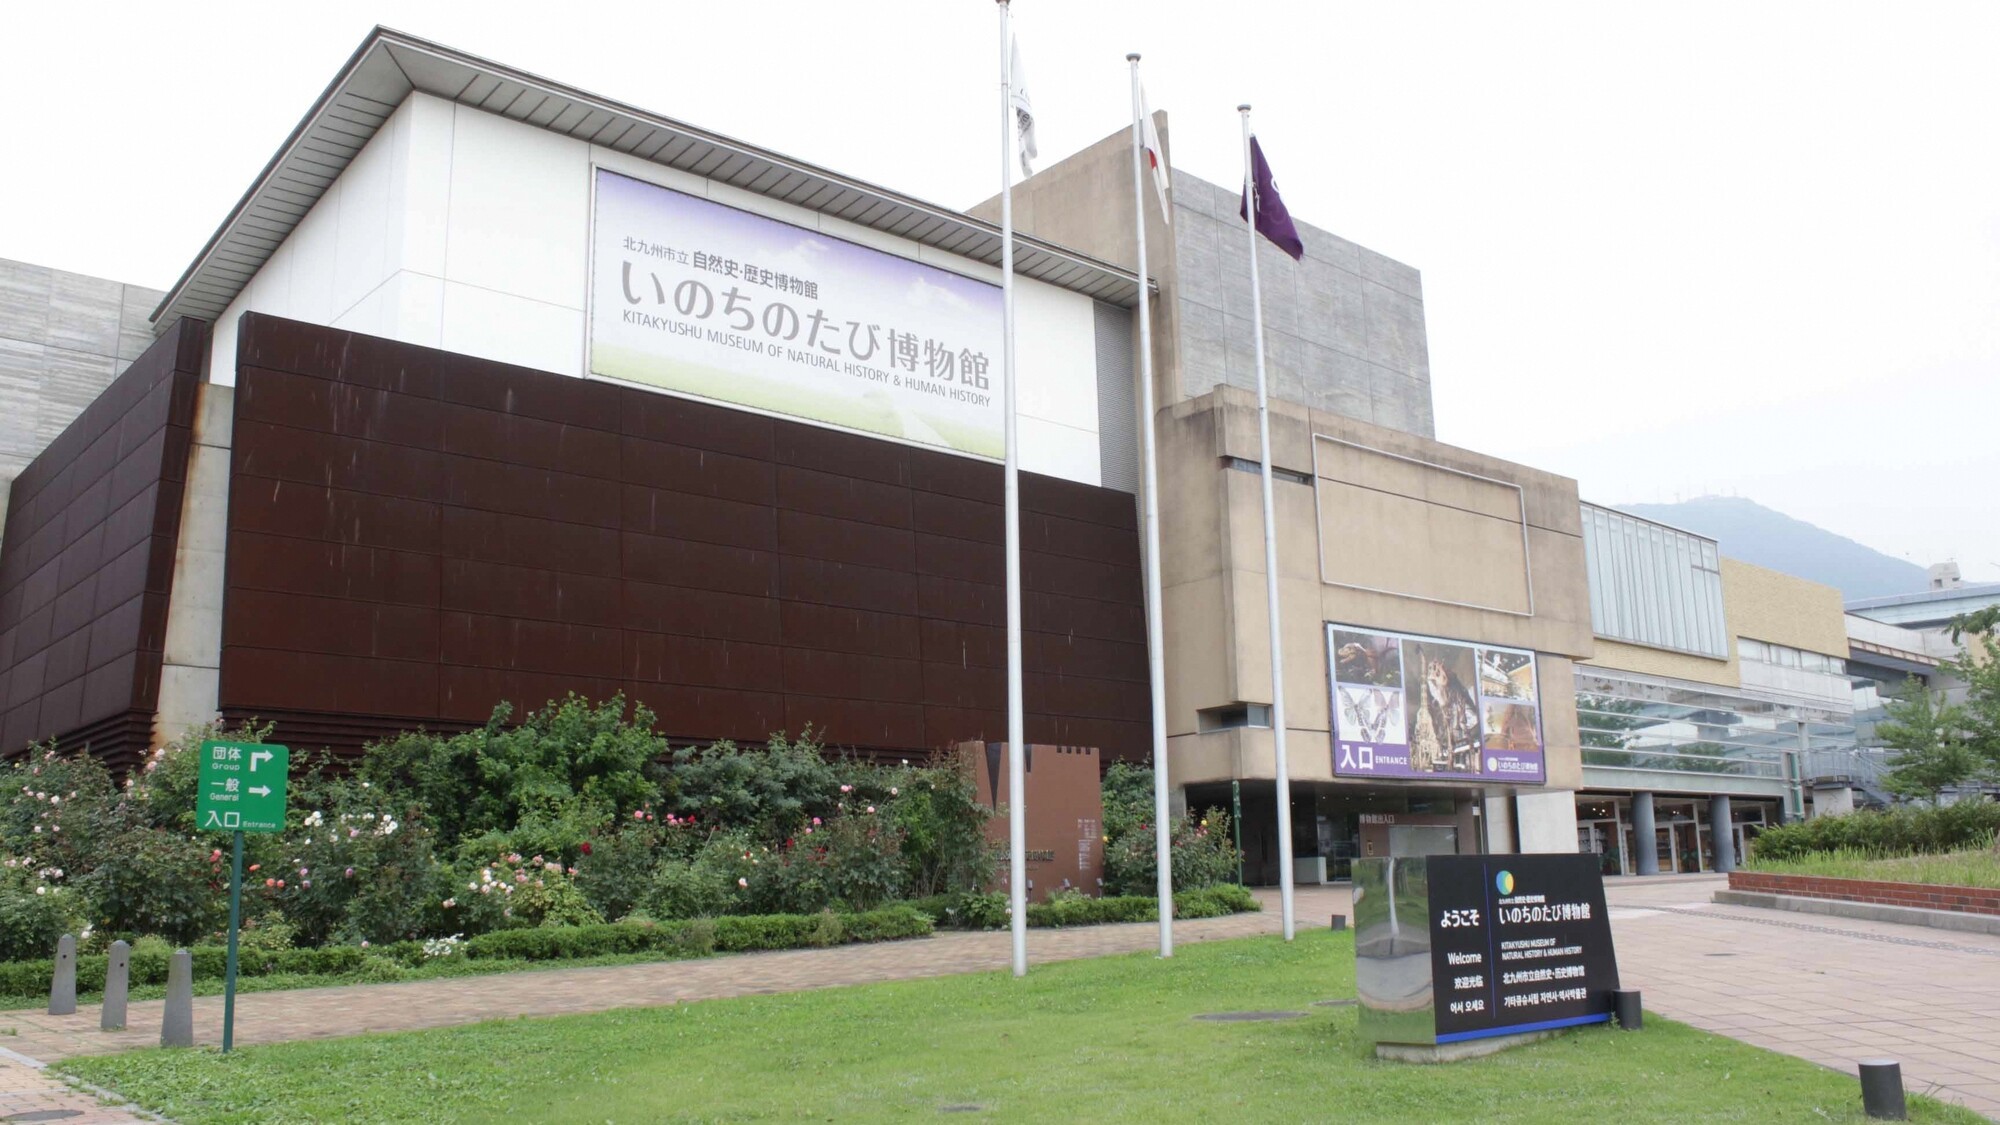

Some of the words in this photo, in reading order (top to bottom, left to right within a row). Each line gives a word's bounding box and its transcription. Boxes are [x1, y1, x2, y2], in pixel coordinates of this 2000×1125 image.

[623, 236, 689, 265] 北九州市立
[621, 260, 990, 390] いのちのたび博物館
[623, 309, 702, 340] KITAKYUSHU
[707, 329, 763, 354] MUSEUM
[767, 343, 783, 358] OF
[787, 349, 840, 372] NATURAL
[844, 361, 889, 384] HISTORY
[893, 374, 901, 386] &
[905, 376, 946, 397] HUMAN
[949, 388, 991, 408] HISTORY
[212, 746, 242, 761] 団体
[1340, 744, 1373, 770] 入口
[1375, 755, 1407, 765] ENTRANCE
[211, 762, 240, 771] Group
[210, 777, 240, 792] 一般
[209, 792, 239, 802] General
[204, 810, 240, 828] 入口
[242, 820, 276, 829] Entrance
[1440, 909, 1480, 928] ようこそ
[1499, 902, 1591, 924] いのちのたび博物館
[1501, 940, 1530, 950] KITAKYUSHU
[1530, 938, 1550, 948] MUSEUM
[1550, 937, 1556, 946] OF
[1447, 951, 1482, 965] Welcome
[1502, 951, 1524, 960] NATURAL
[1525, 948, 1543, 958] HISTORY
[1547, 947, 1564, 956] HUMAN
[1564, 945, 1582, 955] HISTORY
[1450, 1001, 1464, 1014] 어서
[1465, 999, 1485, 1012] 오세요
